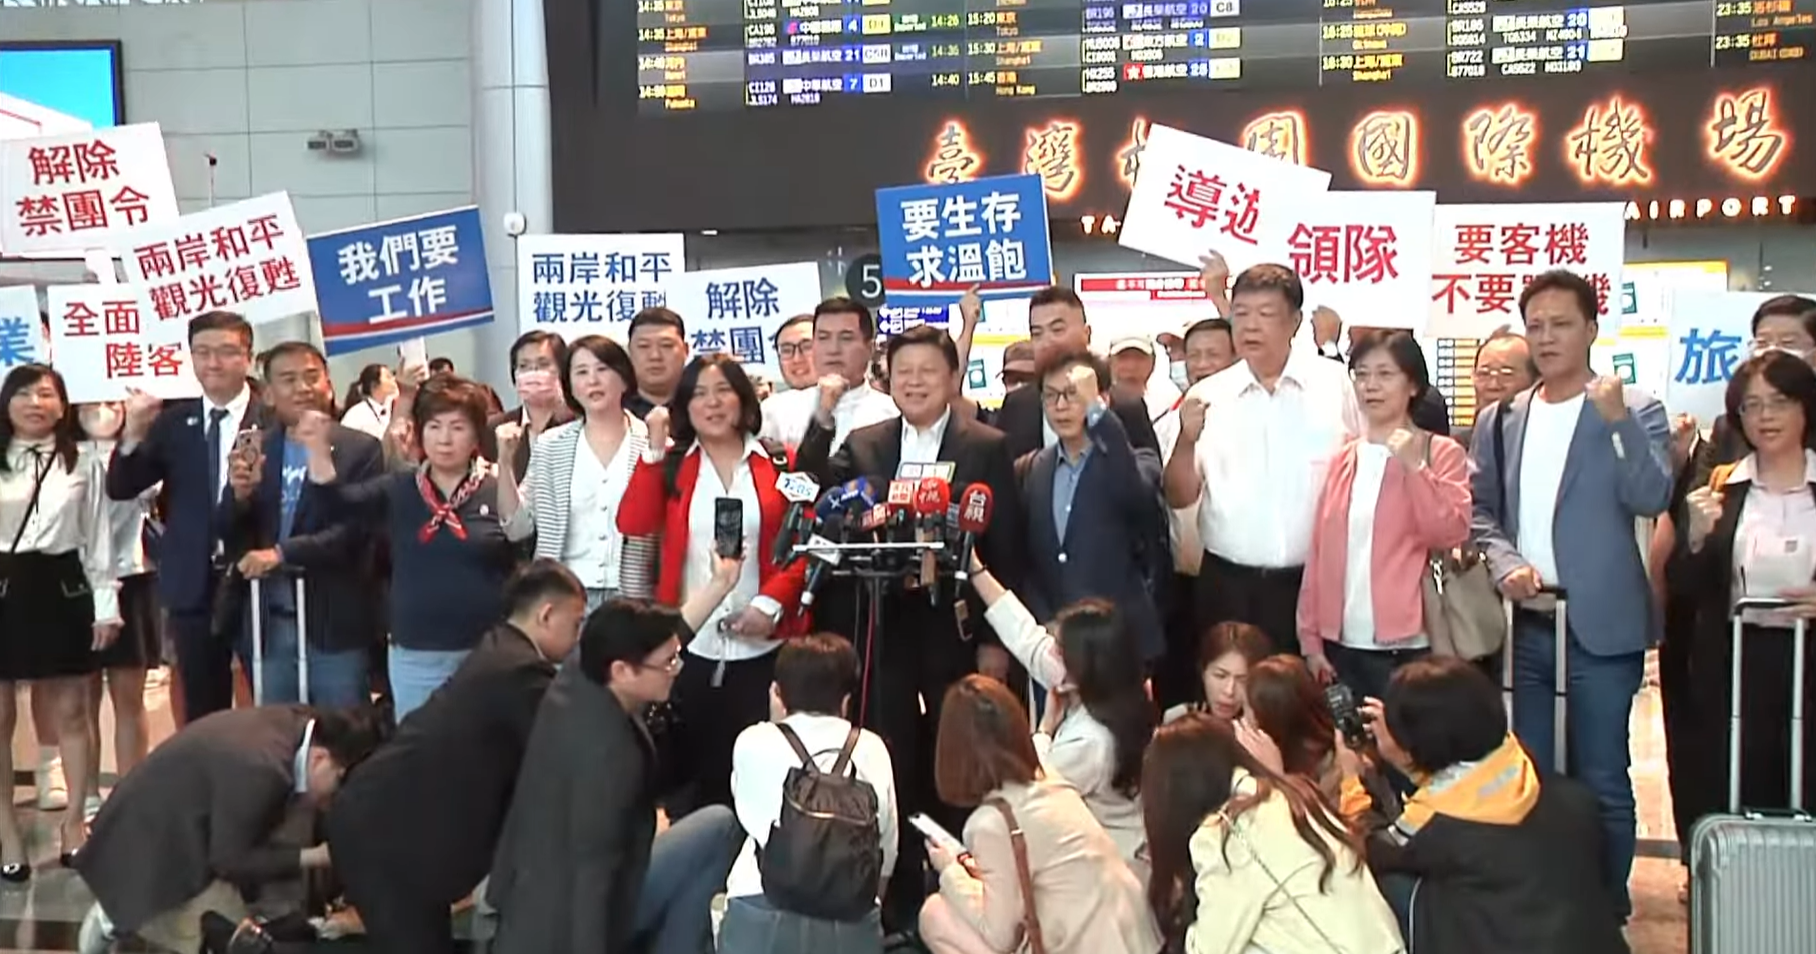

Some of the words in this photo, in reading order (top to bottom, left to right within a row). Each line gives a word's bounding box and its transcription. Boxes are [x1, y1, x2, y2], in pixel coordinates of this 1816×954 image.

[968, 12, 995, 25] 15:20
[1216, 2, 1233, 12] C8
[1717, 2, 1752, 17] 23:35
[1716, 34, 1750, 50] 23:35
[932, 74, 959, 87] 14:40
[968, 72, 995, 84] 15:45
[28, 139, 120, 186] 解除
[16, 186, 150, 236] 禁團令
[901, 192, 1021, 242] 要生存
[1624, 194, 1796, 220] AIRPORT
[134, 214, 284, 280] 兩岸和平
[337, 225, 458, 286] 我們要
[1288, 222, 1399, 285] 領隊
[1454, 222, 1589, 266] 要客機
[532, 252, 673, 285] 兩岸和平
[861, 264, 880, 298] 5
[906, 239, 1027, 288] 求溫飽
[150, 256, 301, 321] 觀光復甦
[367, 276, 447, 325] 工作
[705, 277, 780, 319] 解除
[63, 300, 140, 337] 全面
[106, 342, 183, 379] 陸客
[691, 326, 777, 364] 禁團
[1675, 328, 1742, 385] 旅
[964, 489, 987, 523] 台視
